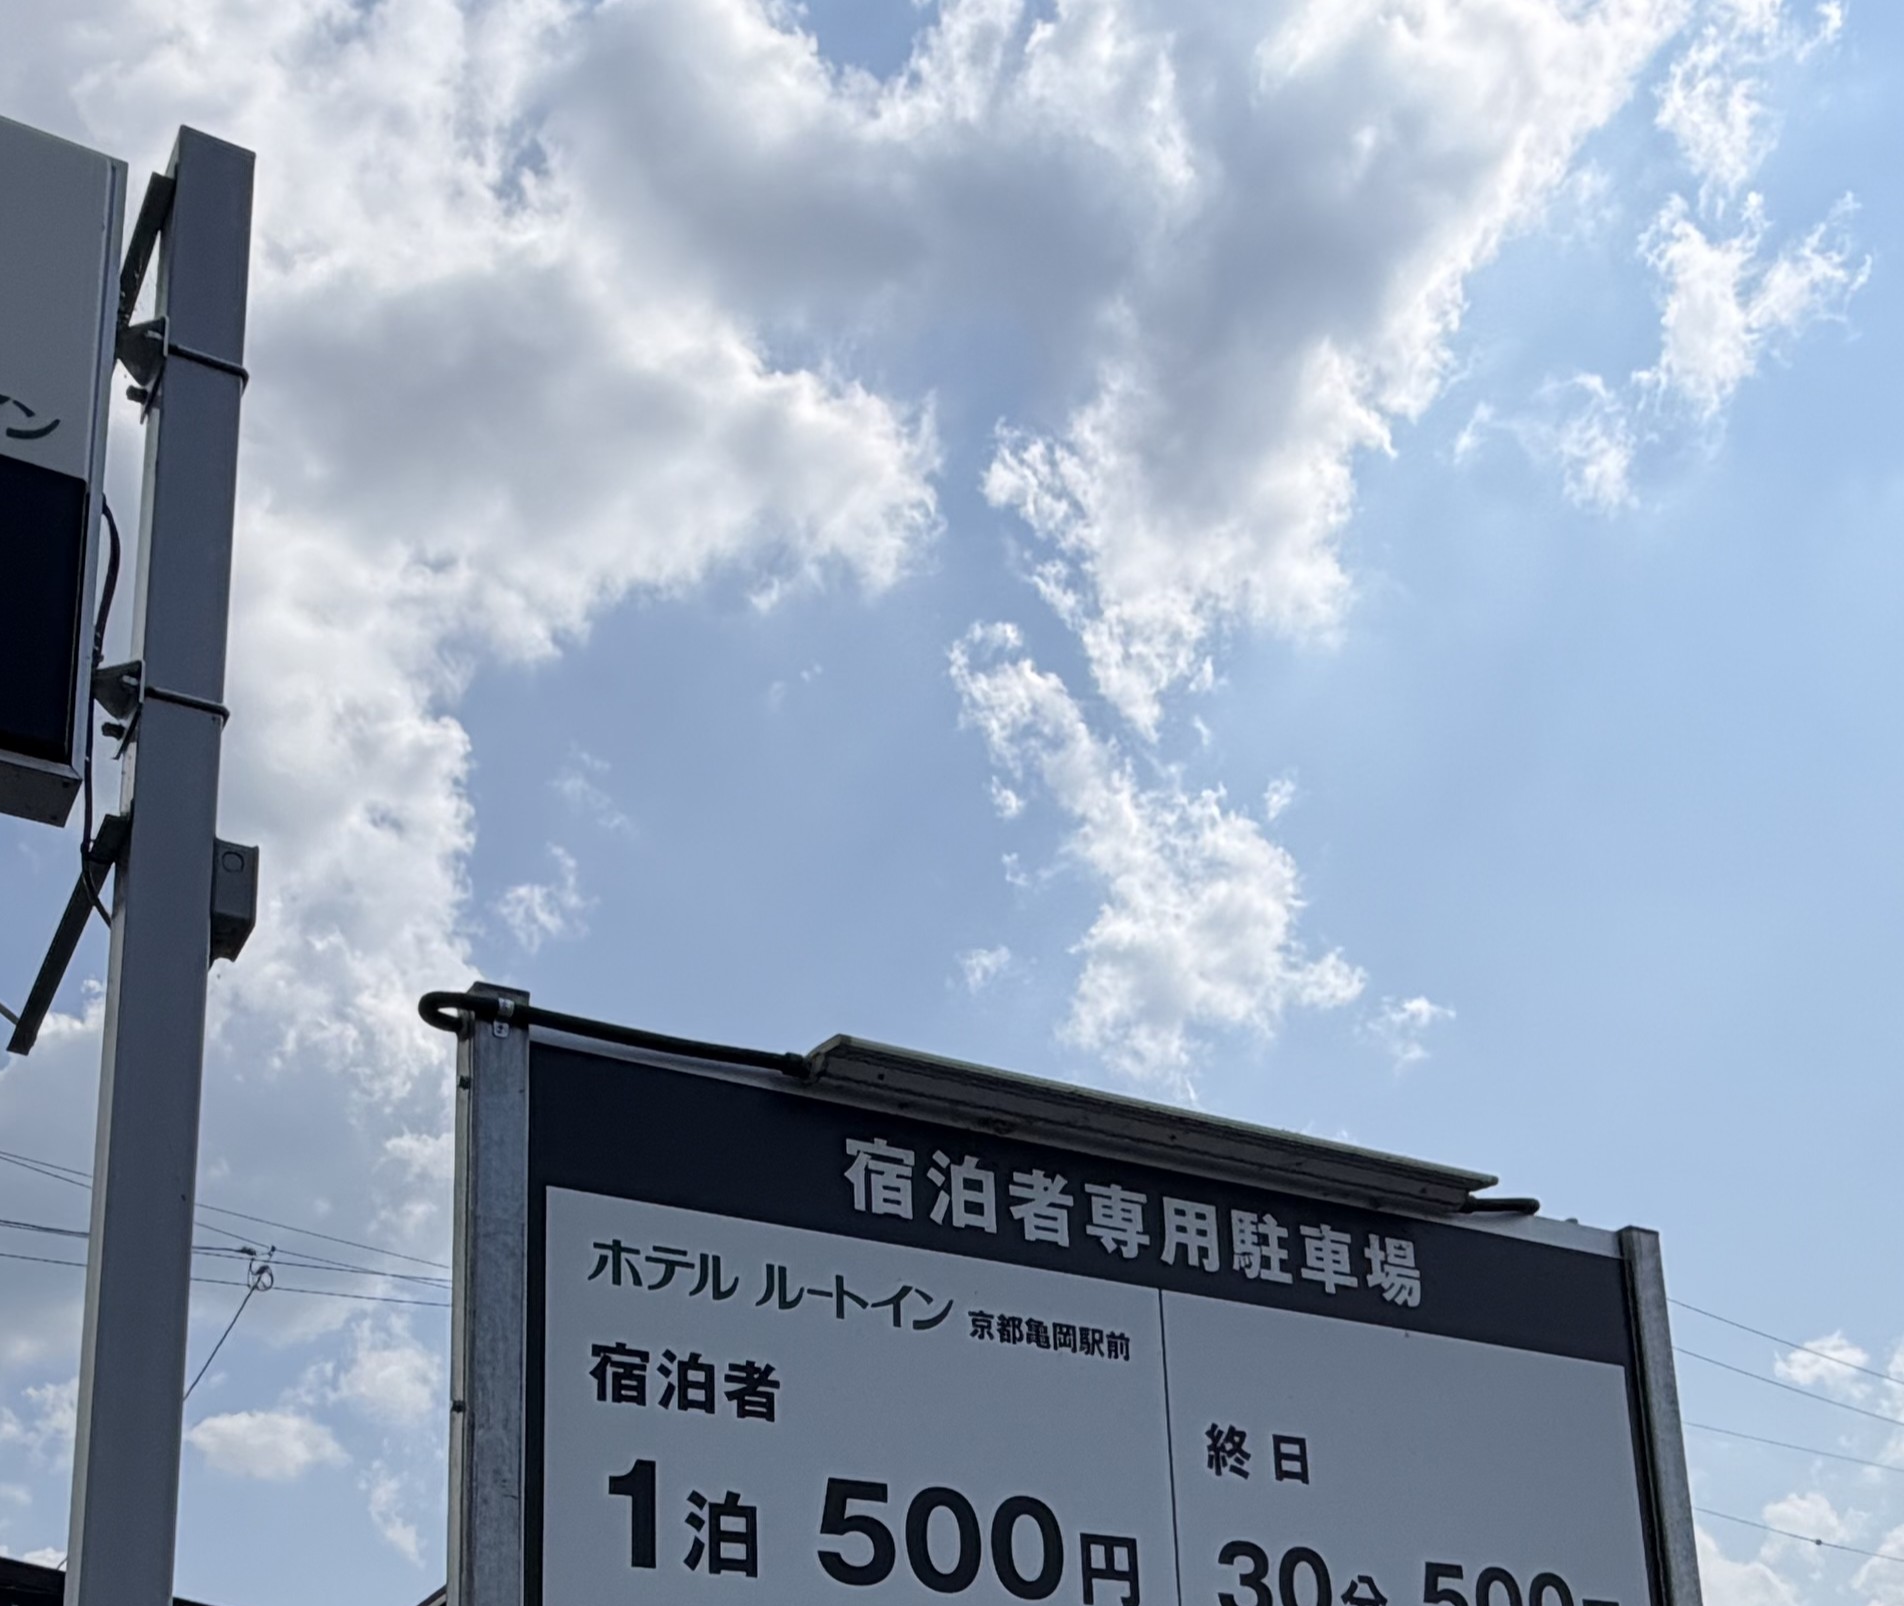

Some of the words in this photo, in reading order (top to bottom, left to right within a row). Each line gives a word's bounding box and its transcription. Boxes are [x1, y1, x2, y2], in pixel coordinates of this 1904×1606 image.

[844, 1138, 1421, 1307] 宿泊者専用駐車場
[588, 1239, 739, 1300] ホテル
[756, 1264, 953, 1330] ルートイン
[968, 1311, 1130, 1361] 京都亀岡駅前
[590, 1342, 780, 1422] 宿泊者
[1205, 1422, 1310, 1485] 終日
[609, 1459, 757, 1578] 1泊
